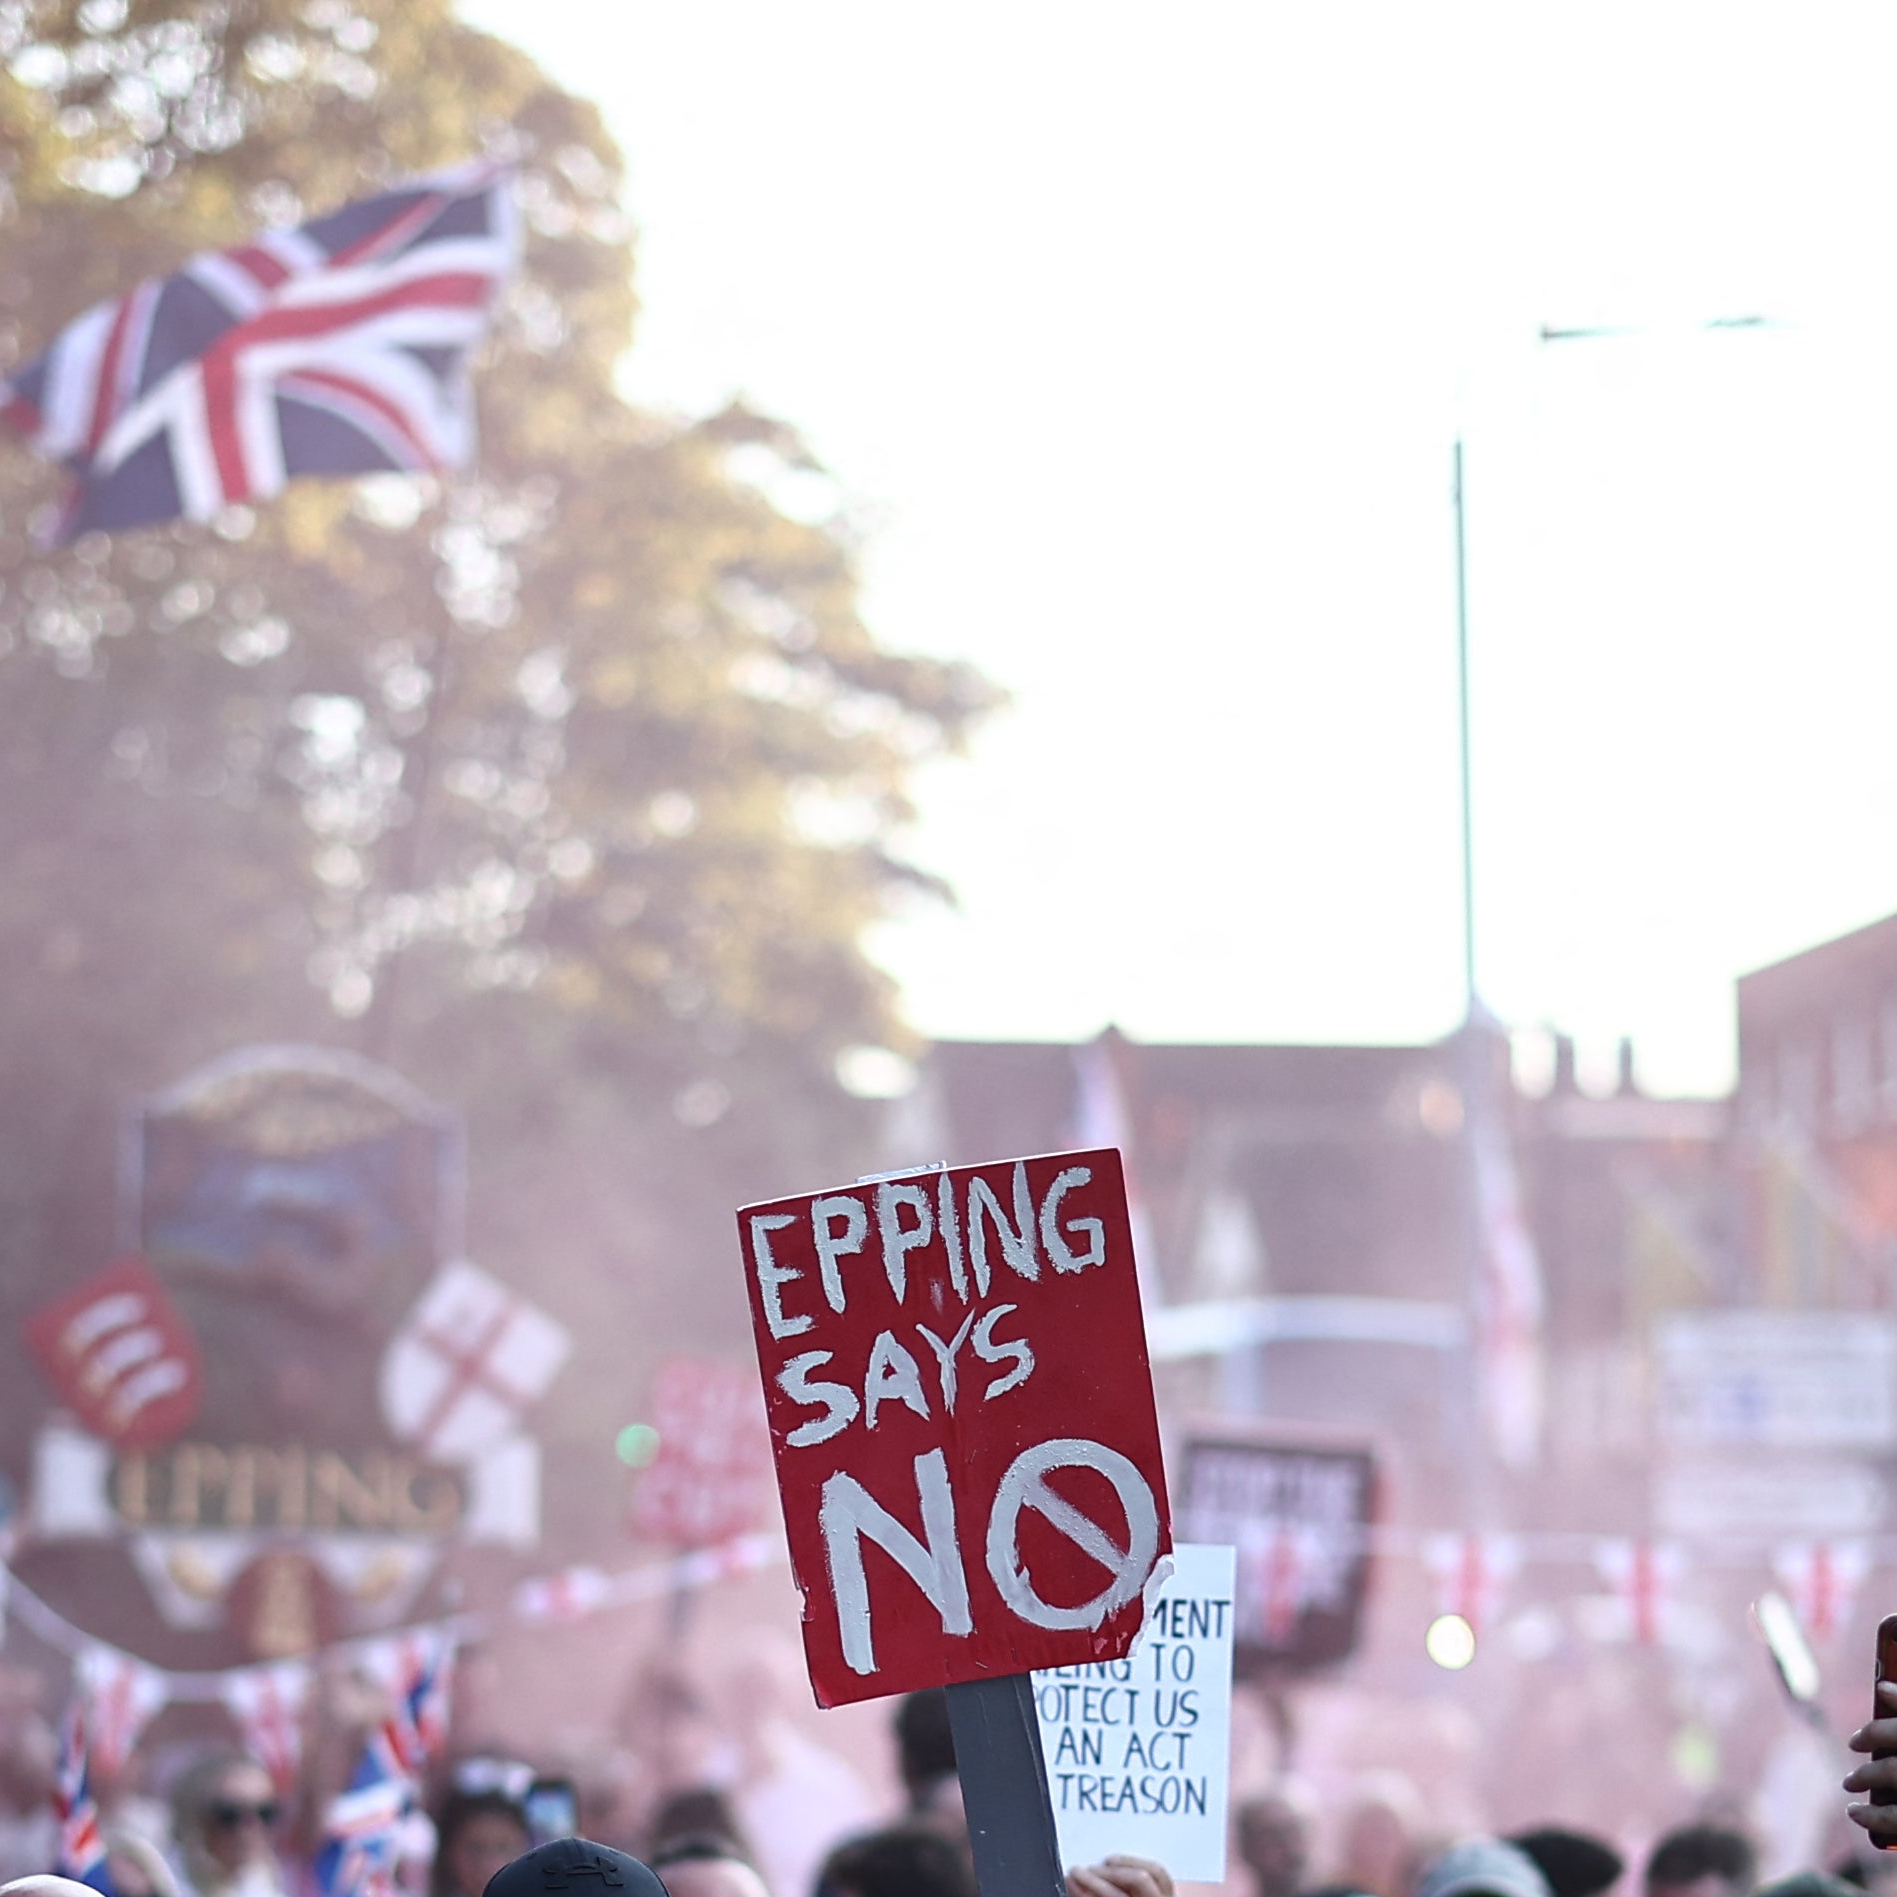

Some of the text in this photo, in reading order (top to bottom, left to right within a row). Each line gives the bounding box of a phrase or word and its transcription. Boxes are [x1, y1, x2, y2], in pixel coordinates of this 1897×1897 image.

[751, 1162, 1105, 1340] EPPING
[776, 1304, 1036, 1448] SAYS
[819, 1439, 1161, 1675] NO
[1153, 1597, 1231, 1639] MENT
[1150, 1643, 1195, 1682] TO
[1035, 1684, 1199, 1727] OTECT US
[1055, 1726, 1192, 1771] AN ACT
[1056, 1773, 1207, 1816] TREASON
